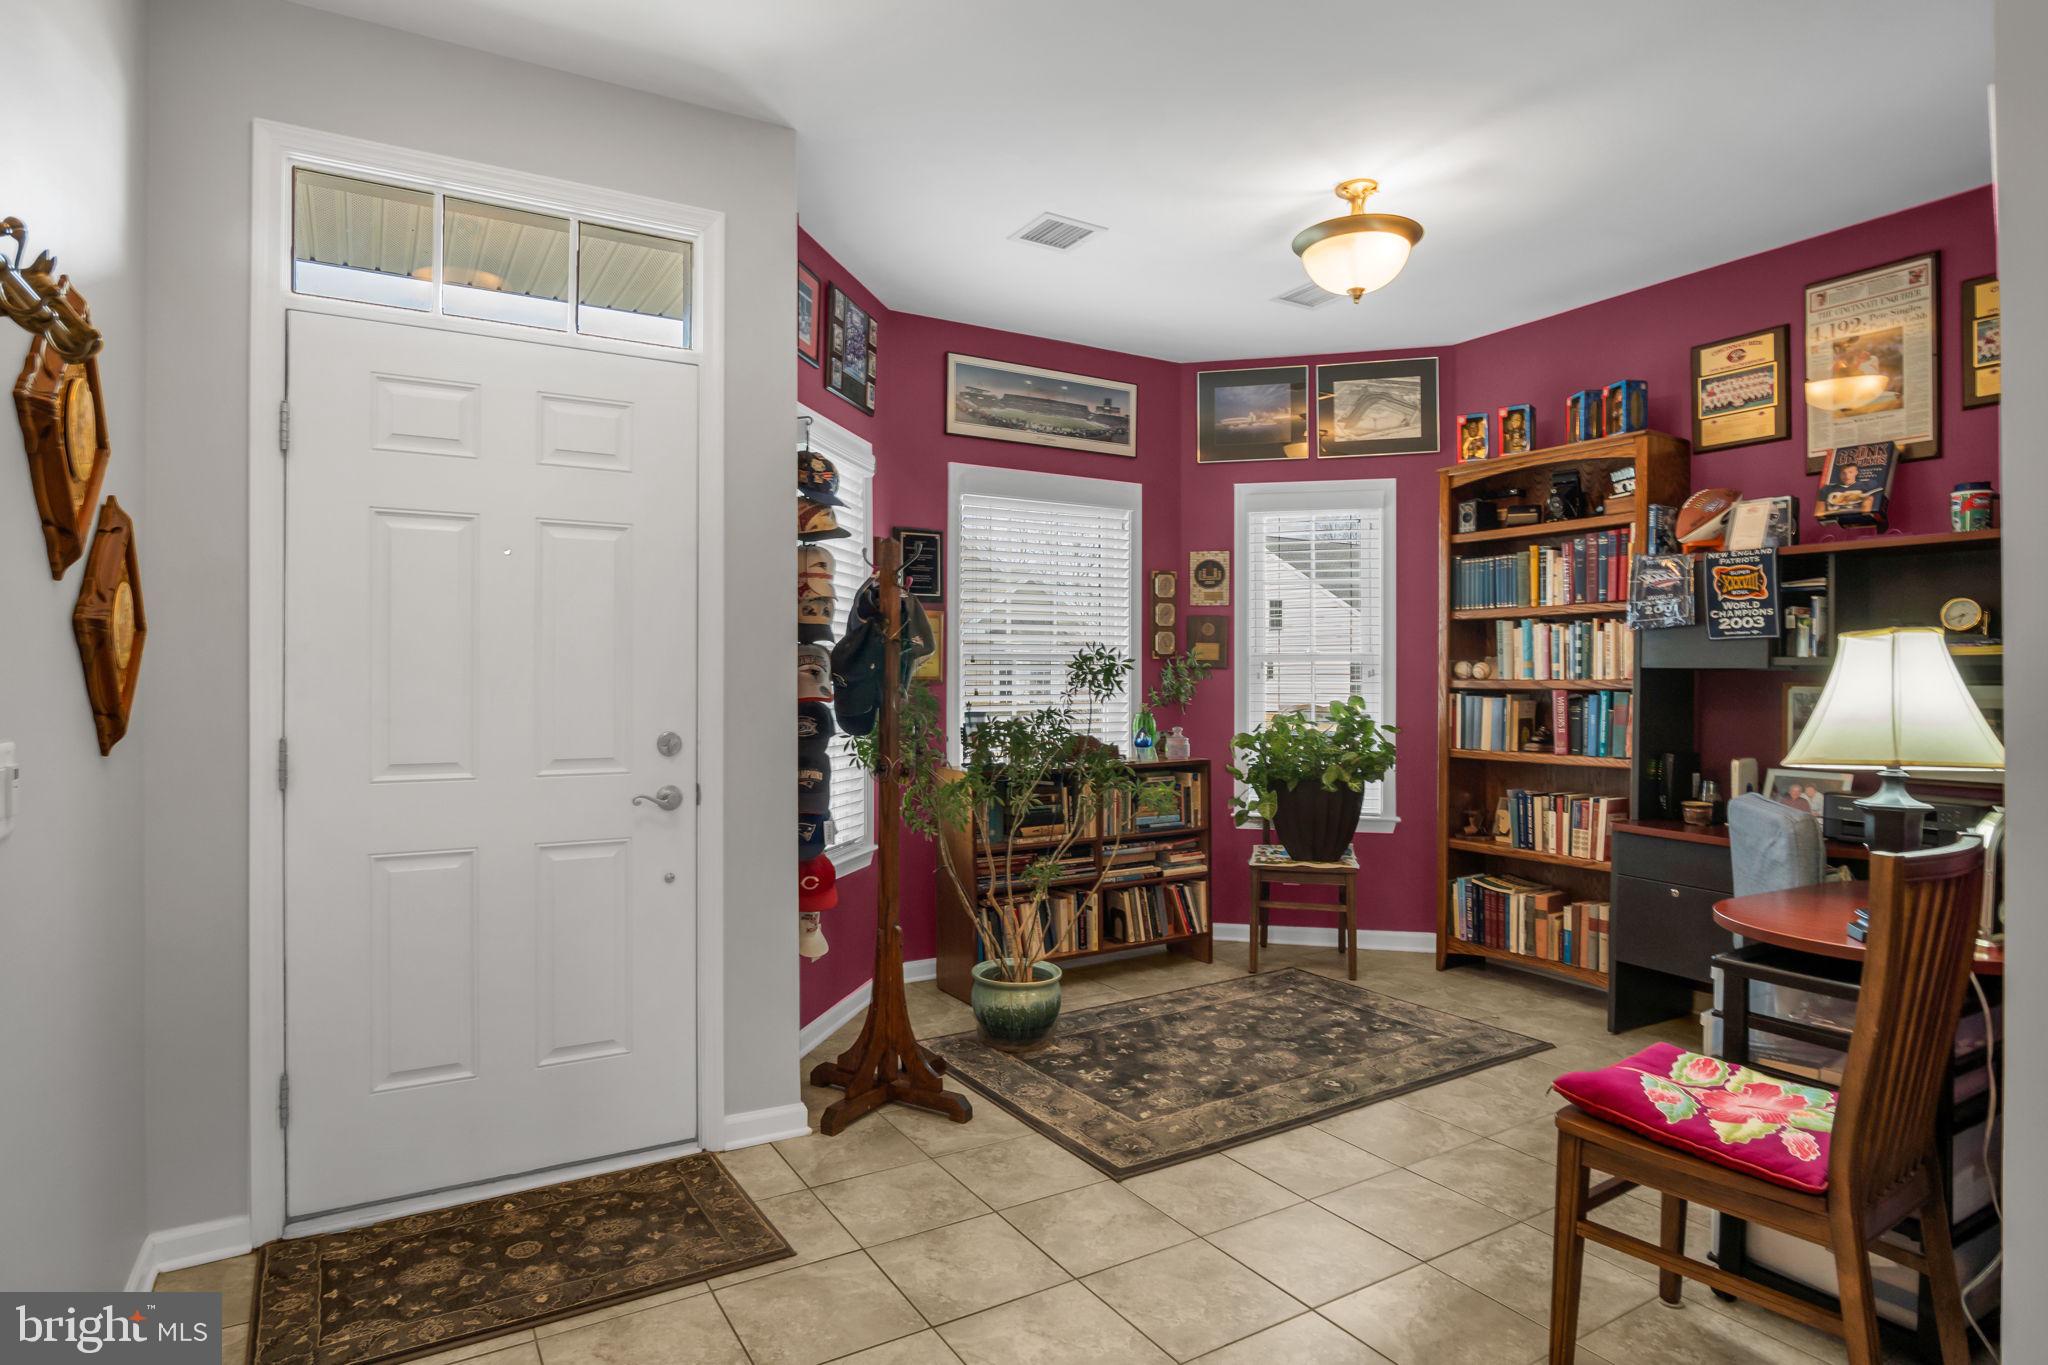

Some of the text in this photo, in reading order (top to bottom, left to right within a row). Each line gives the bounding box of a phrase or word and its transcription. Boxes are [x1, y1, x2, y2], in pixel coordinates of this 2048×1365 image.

[1731, 548, 1773, 557] ENGLAND
[1719, 556, 1760, 565] PATRIOTS
[1722, 602, 1760, 610] WORLD
[1709, 608, 1774, 618] CHAMPIONS
[1718, 617, 1765, 629] 2003
[800, 875, 819, 890] C
